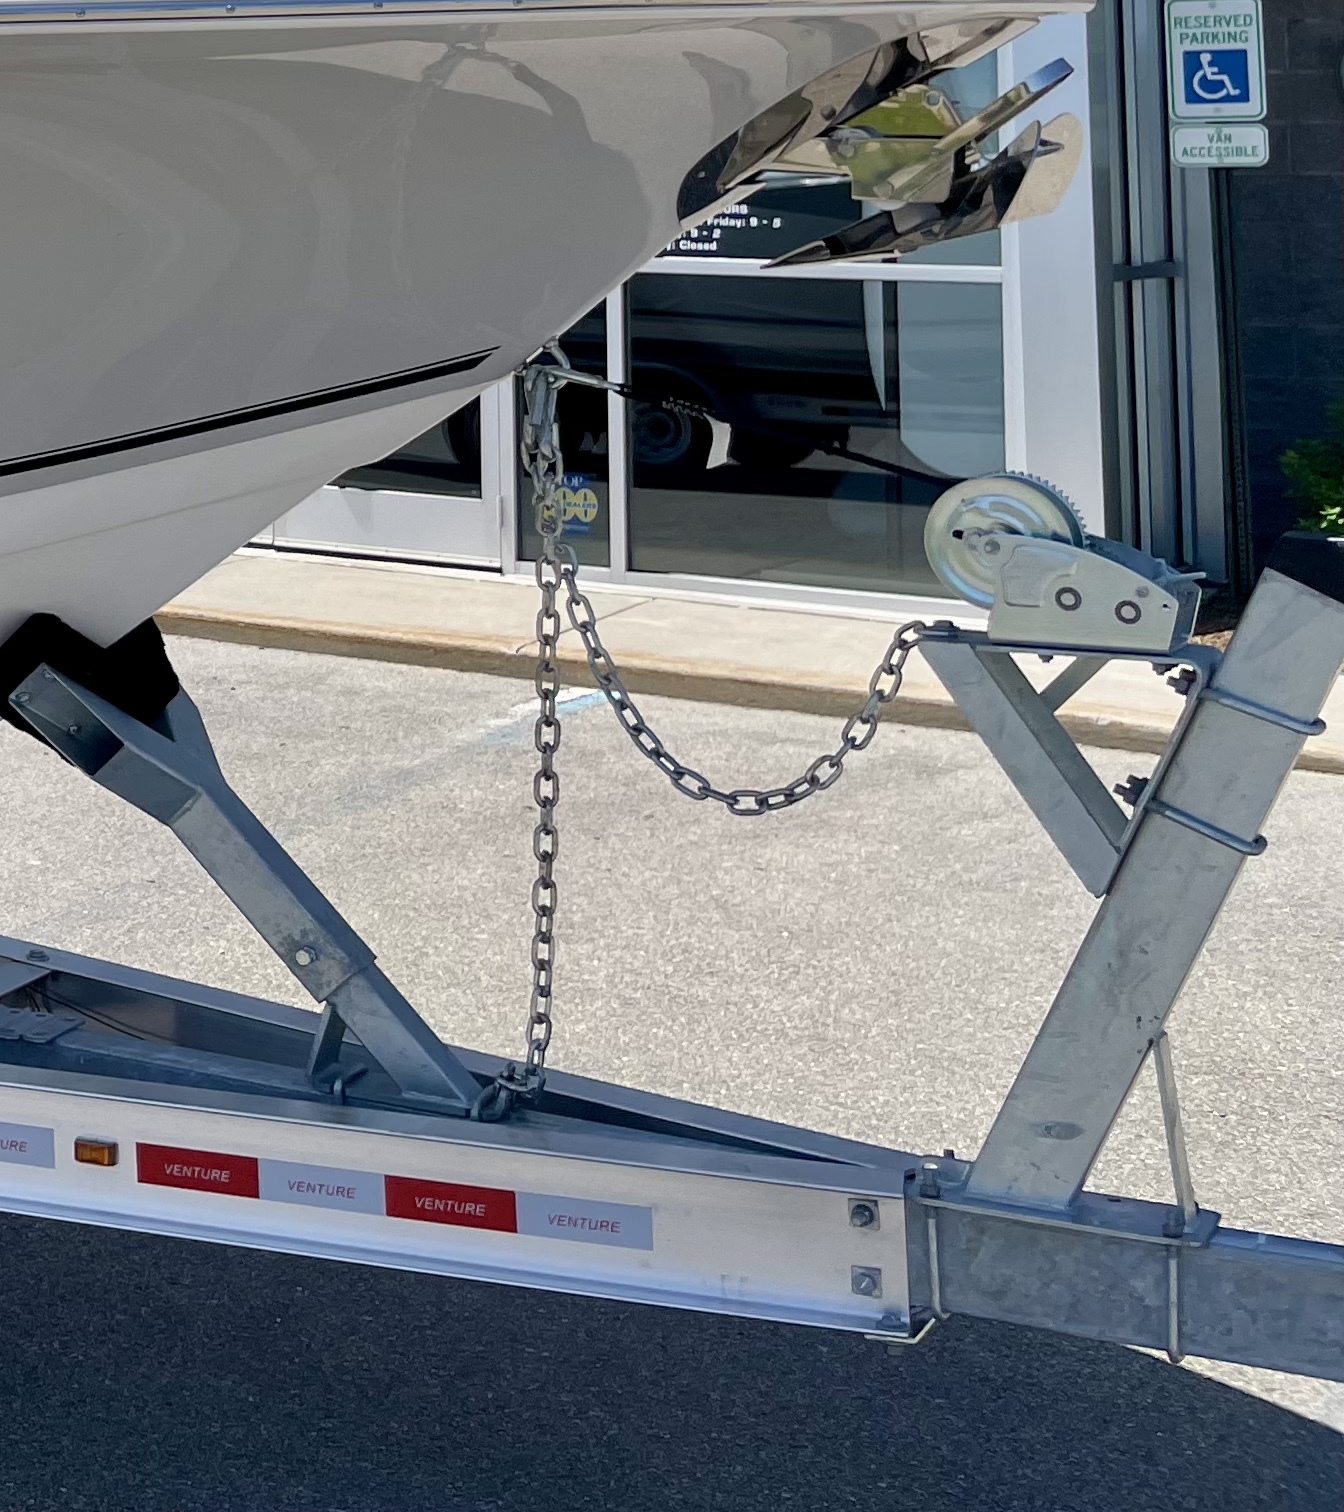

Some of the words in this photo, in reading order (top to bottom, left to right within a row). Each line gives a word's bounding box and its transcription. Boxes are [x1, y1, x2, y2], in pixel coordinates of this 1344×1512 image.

[1173, 13, 1254, 30] RESERVED
[1179, 30, 1249, 45] PARKING
[1207, 133, 1232, 145] VAN
[1181, 145, 1259, 158] ACCESSIBLE
[679, 239, 717, 251] Closed
[164, 1163, 230, 1183] VENTURE
[287, 1179, 356, 1199] VENTURE
[414, 1196, 486, 1217] VENTURE
[547, 1213, 622, 1233] VENTURE
